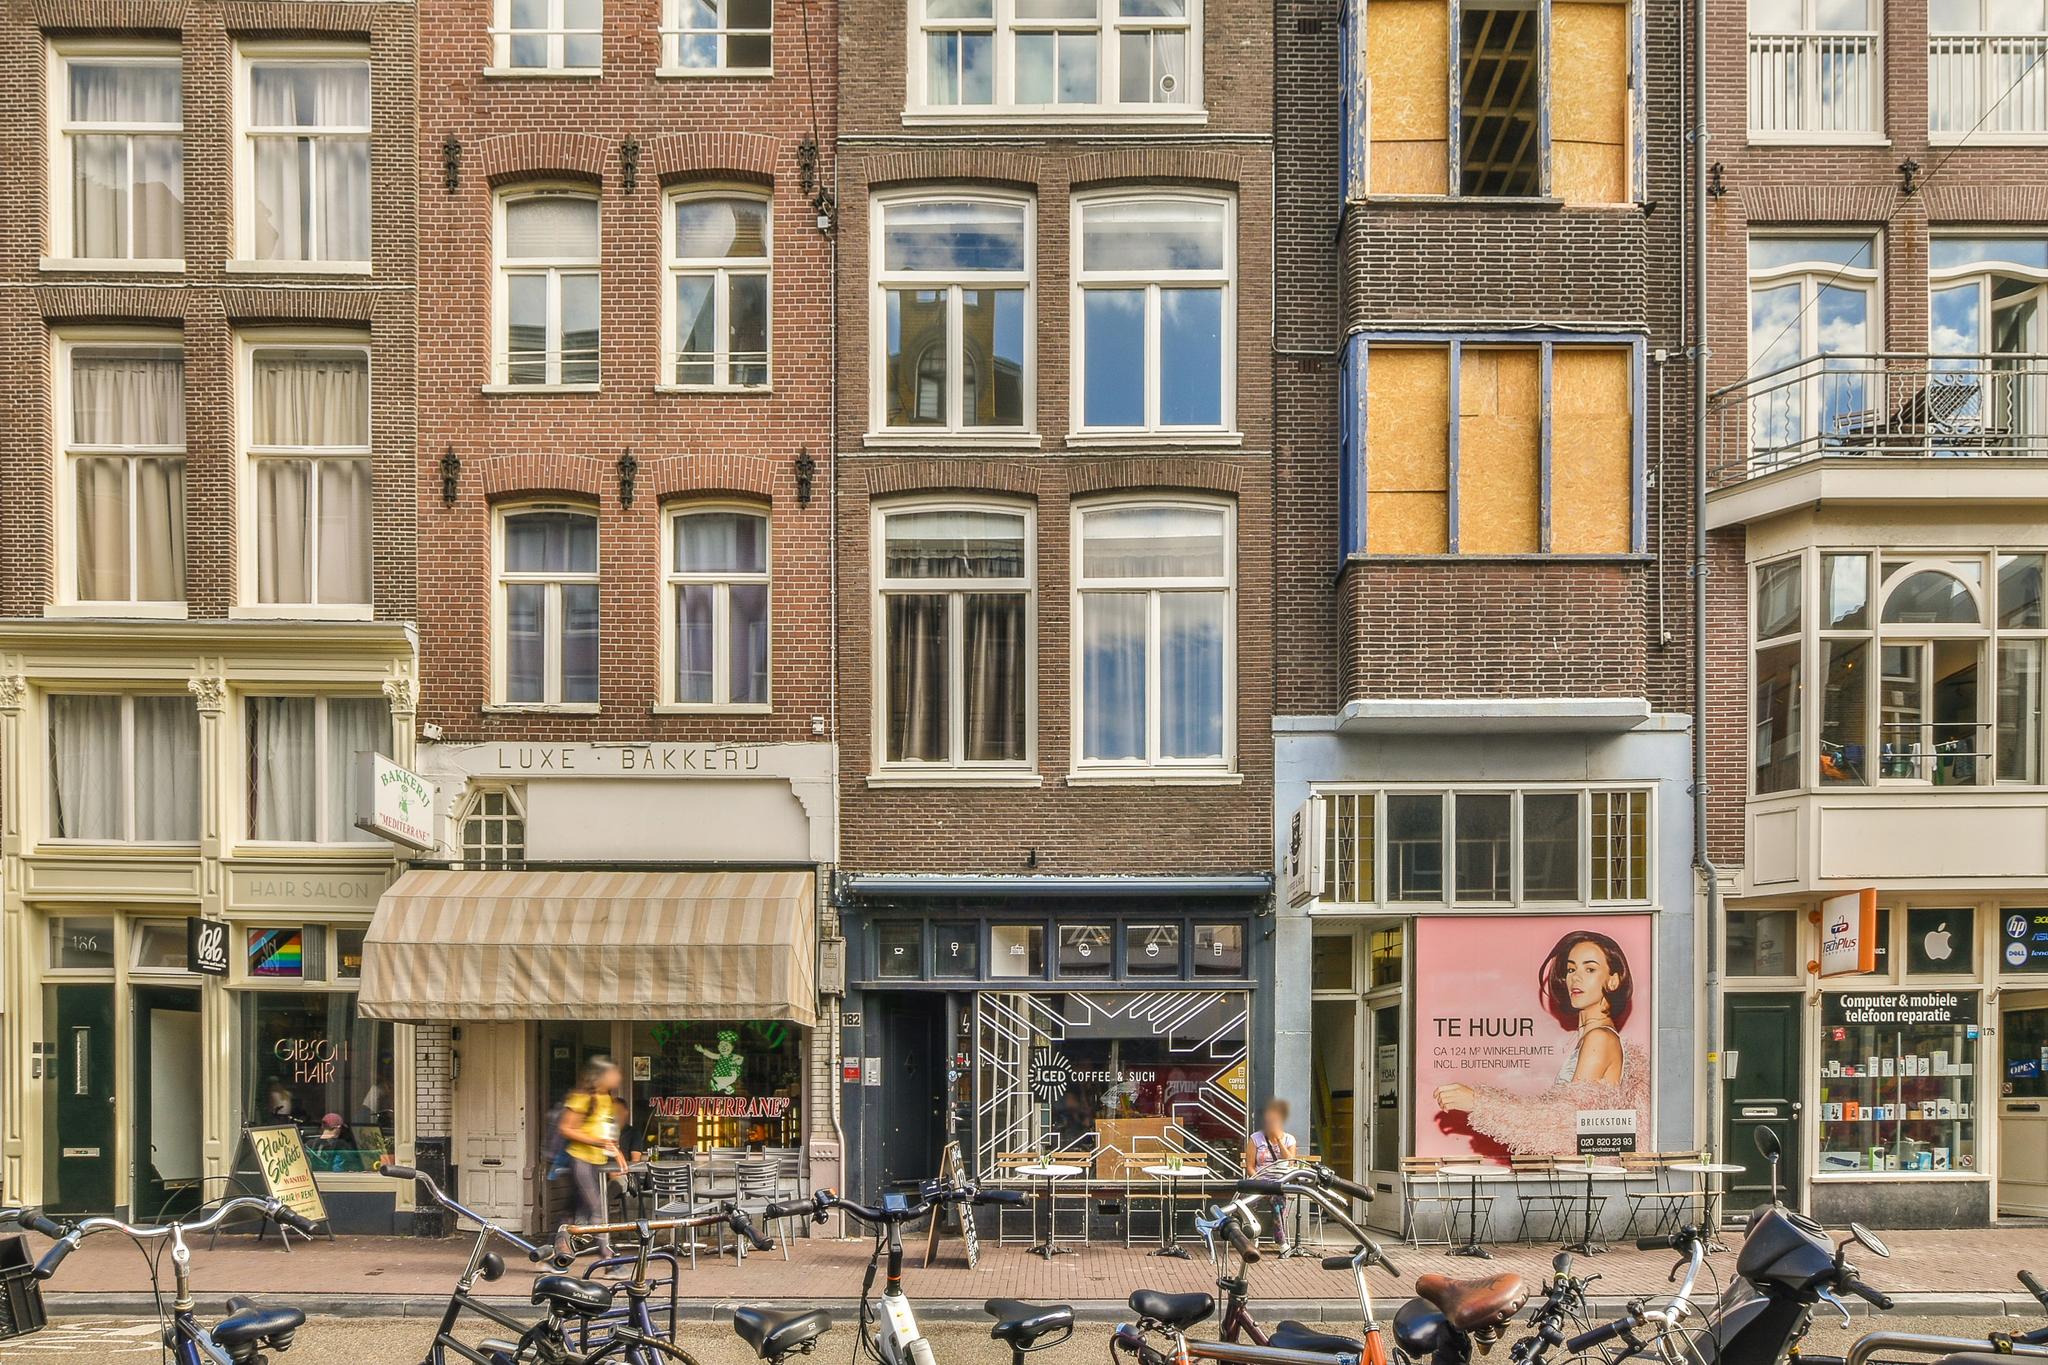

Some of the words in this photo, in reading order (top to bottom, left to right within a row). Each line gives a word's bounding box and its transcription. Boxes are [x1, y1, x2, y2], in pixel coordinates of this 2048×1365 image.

[499, 748, 575, 769] LUXE
[380, 769, 431, 808] BAKKERIJ
[250, 880, 296, 897] HAIR
[302, 881, 369, 899] SALON
[2008, 915, 2026, 937] hp
[72, 935, 97, 951] 186
[1822, 937, 1857, 953] TechPlus
[1840, 994, 1897, 1010] Computer
[1899, 994, 1909, 1008] &
[1910, 993, 1957, 1008] mobiele
[843, 1013, 860, 1026] 182
[1845, 1008, 1895, 1022] telefoon
[1897, 1008, 1951, 1025] reparatie
[1433, 1018, 1462, 1037] TE
[1469, 1017, 1534, 1037] HUUR
[274, 1038, 348, 1062] GIBSON
[1433, 1047, 1448, 1056] CA
[1450, 1046, 1467, 1056] 124
[1483, 1046, 1554, 1056] WINKELRUIMTE
[1433, 1060, 1458, 1069] INCL.
[1461, 1059, 1531, 1069] BUITENRUIMTE
[2010, 1062, 2036, 1075] OPEN
[295, 1062, 335, 1084] HAIR
[1071, 1071, 1111, 1082] COFFEE
[1117, 1071, 1124, 1082] &
[1129, 1071, 1155, 1083] SUCH
[1580, 1117, 1632, 1127] BRICKSTONE
[256, 1130, 291, 1163] Hair
[1580, 1138, 1594, 1147] 020
[1612, 1137, 1622, 1146] 23
[1623, 1137, 1633, 1146] 93
[267, 1144, 301, 1184] Stylist
[300, 1189, 314, 1200] RENT
